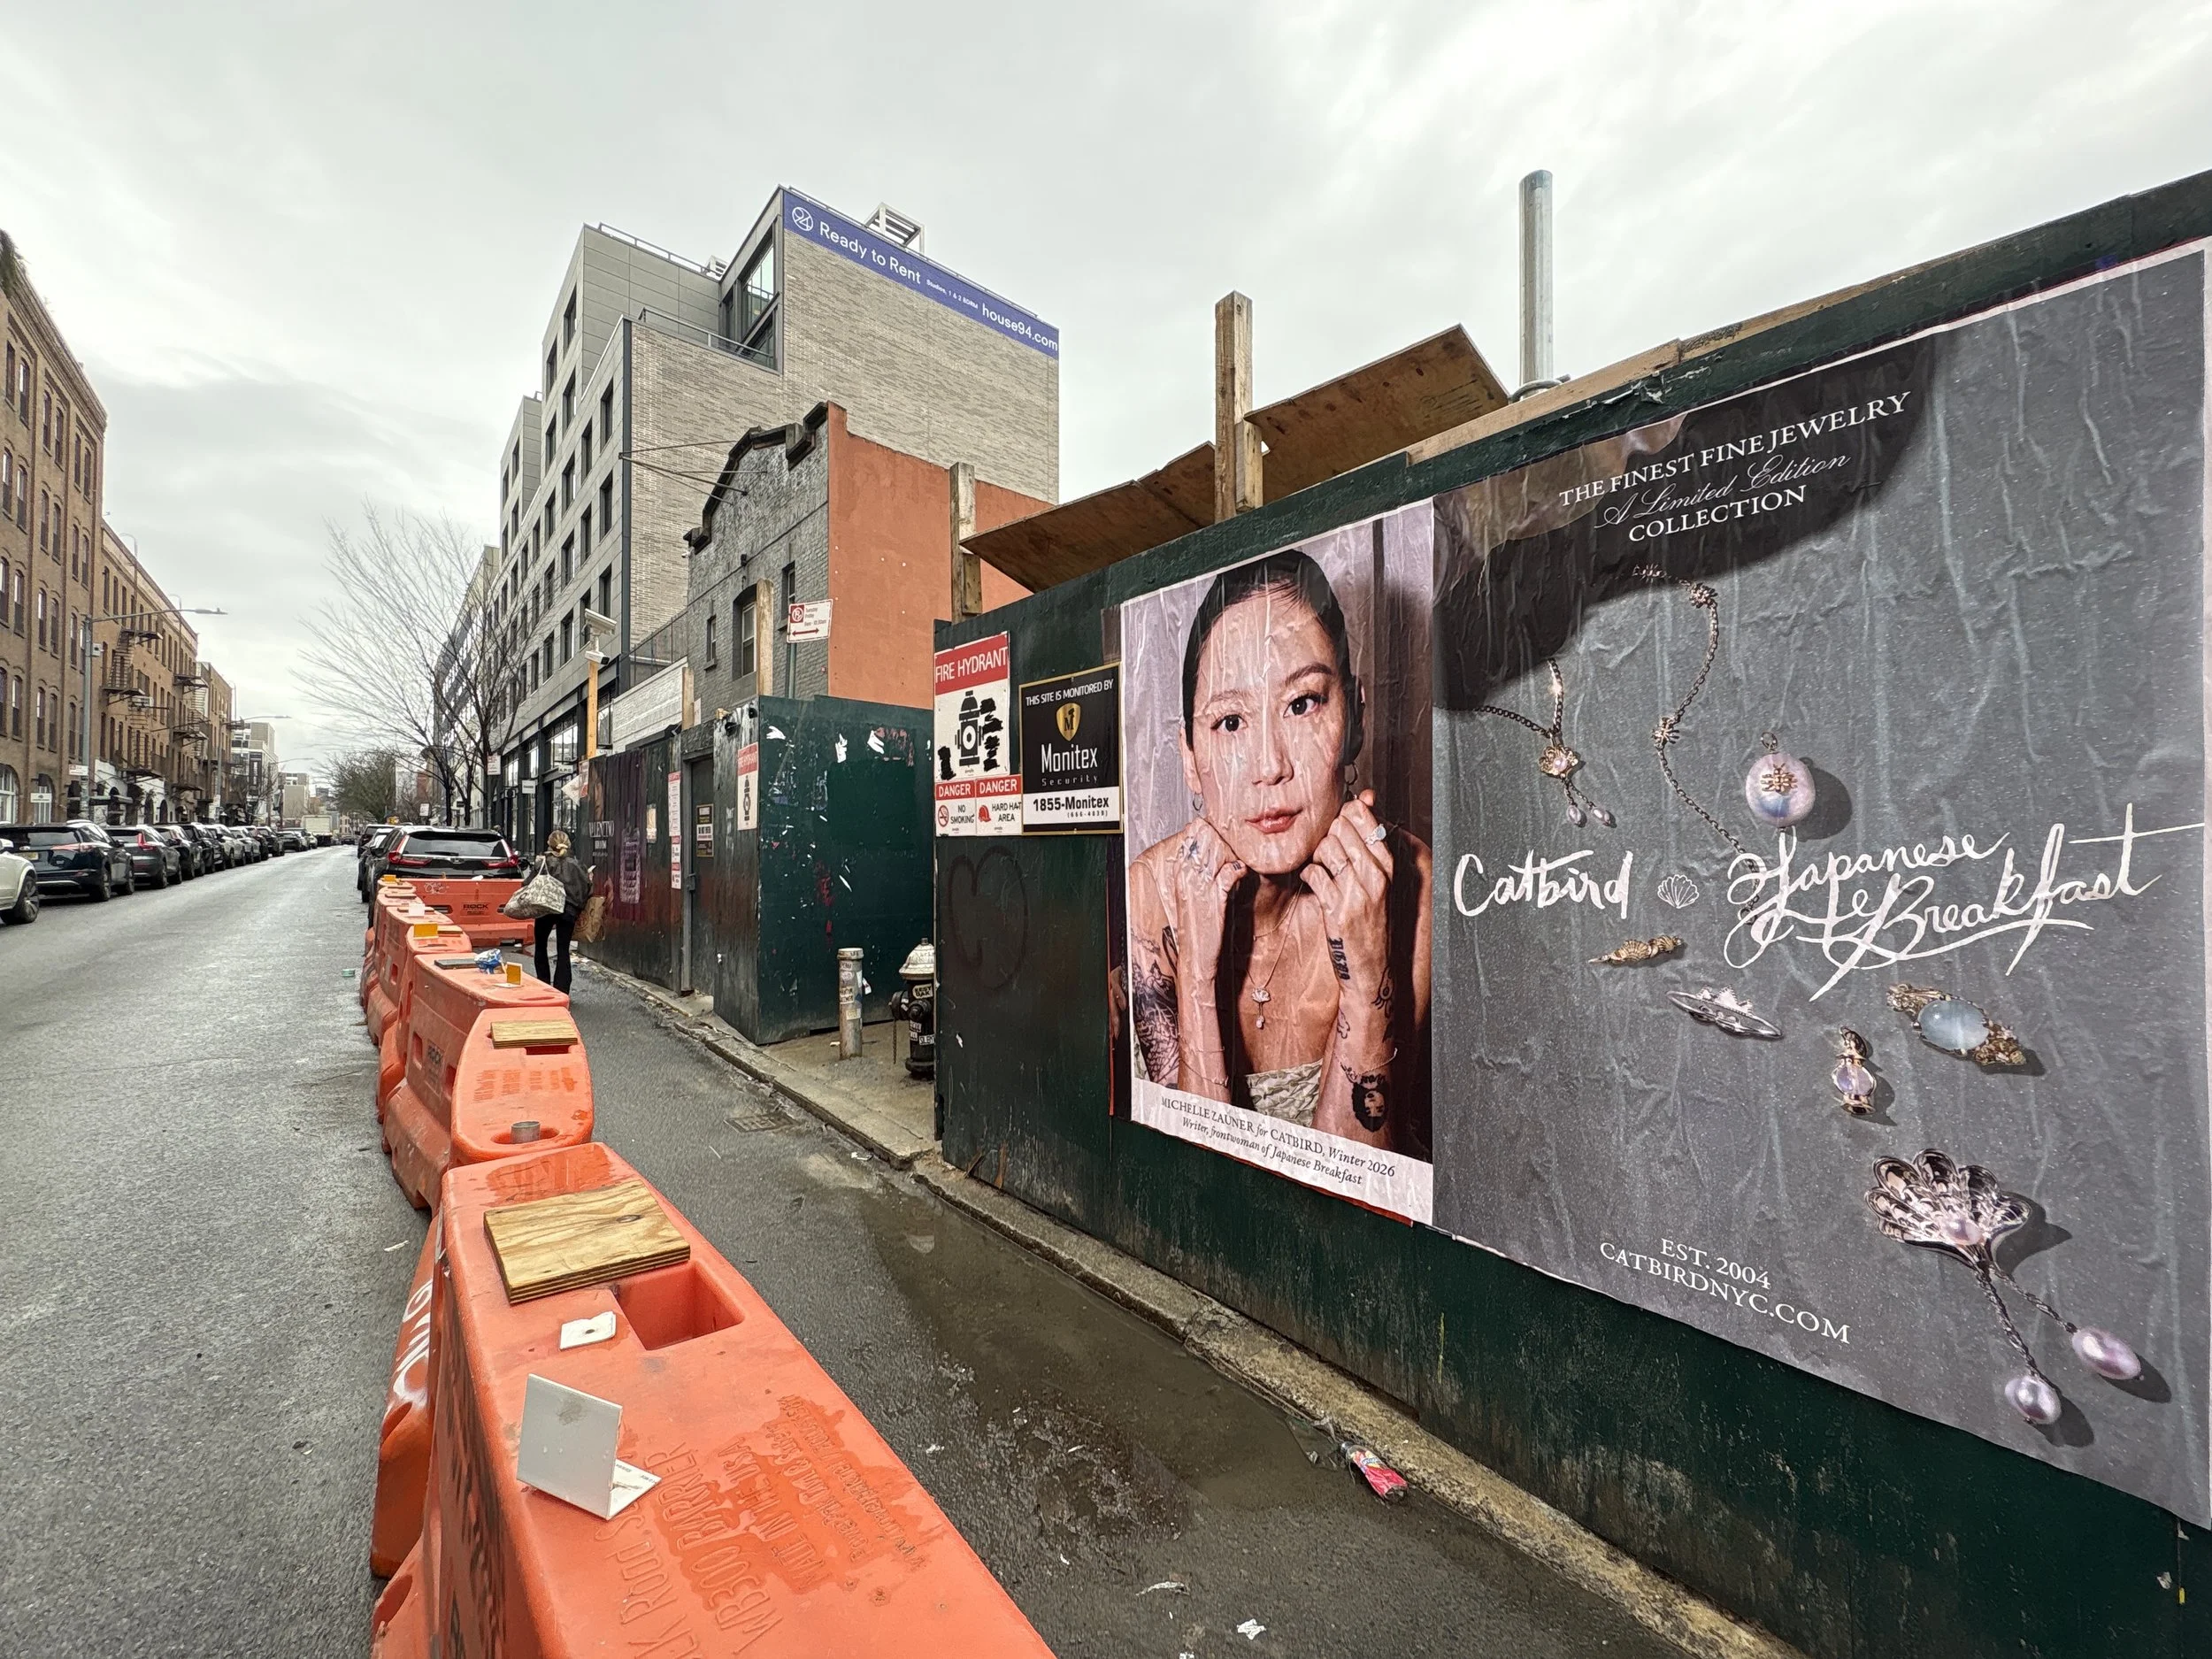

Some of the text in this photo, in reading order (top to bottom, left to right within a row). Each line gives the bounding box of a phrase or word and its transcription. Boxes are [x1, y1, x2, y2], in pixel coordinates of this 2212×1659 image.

[819, 220, 867, 260] Ready
[871, 250, 886, 266] to
[889, 256, 921, 284] Rent
[982, 303, 1058, 351] house94.com
[1559, 391, 1911, 508] THE FINEST FINE JEWELRY
[1594, 449, 1854, 530] A Limited Edition
[1627, 484, 1808, 543] COLLECTION
[934, 646, 1009, 684] FIRE HYDRANT
[1025, 678, 1114, 707] THIS SITE IS MONITORED BY
[1041, 743, 1098, 773] Monitex
[1041, 775, 1099, 786] Security
[938, 783, 972, 798] DANGER
[957, 804, 966, 813] NO
[979, 779, 1018, 794] DANGER
[992, 801, 1008, 812] HARD
[1033, 795, 1110, 812] 1855-Monitex
[950, 814, 974, 825] SMOKING
[1454, 830, 2010, 969] Catbird Japanese
[1161, 1096, 1395, 1178] MICHELLE ZAUNER for CATBIRD, Winter 2026
[1182, 1117, 1363, 1186] Writer, frontwoman of Japanese Breakfast
[1660, 1238, 1771, 1290] EST. 2004
[1599, 1241, 1851, 1345] CATBIRDNYC.COM
[710, 1435, 764, 1487] USA
[644, 1441, 731, 1550] BARRIER
[768, 1530, 833, 1591] MADE
[691, 1545, 784, 1655] WB300
